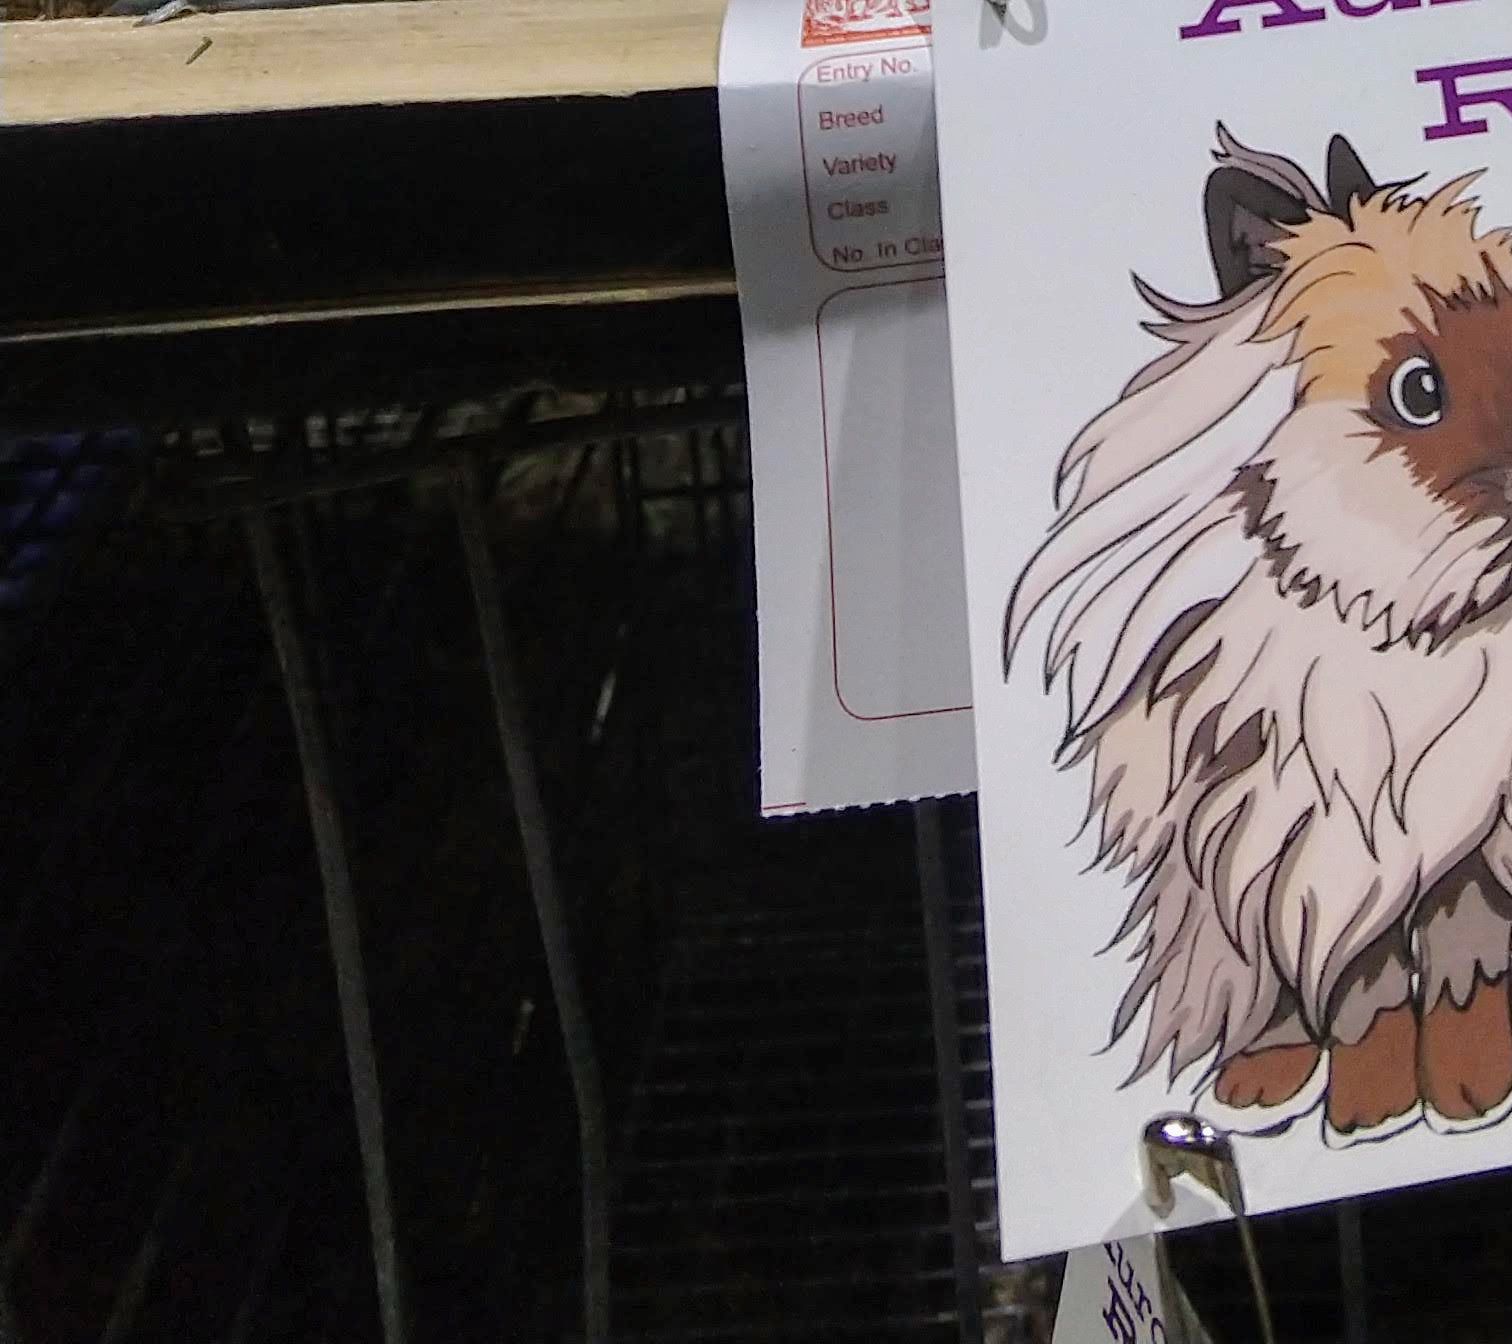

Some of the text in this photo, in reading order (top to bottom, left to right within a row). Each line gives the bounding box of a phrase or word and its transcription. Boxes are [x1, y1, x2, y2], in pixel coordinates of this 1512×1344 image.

[816, 57, 918, 83] Entry No.
[818, 104, 885, 130] Breed
[822, 152, 898, 176] Variety
[827, 199, 890, 220] Class
[904, 235, 943, 257] Cla
